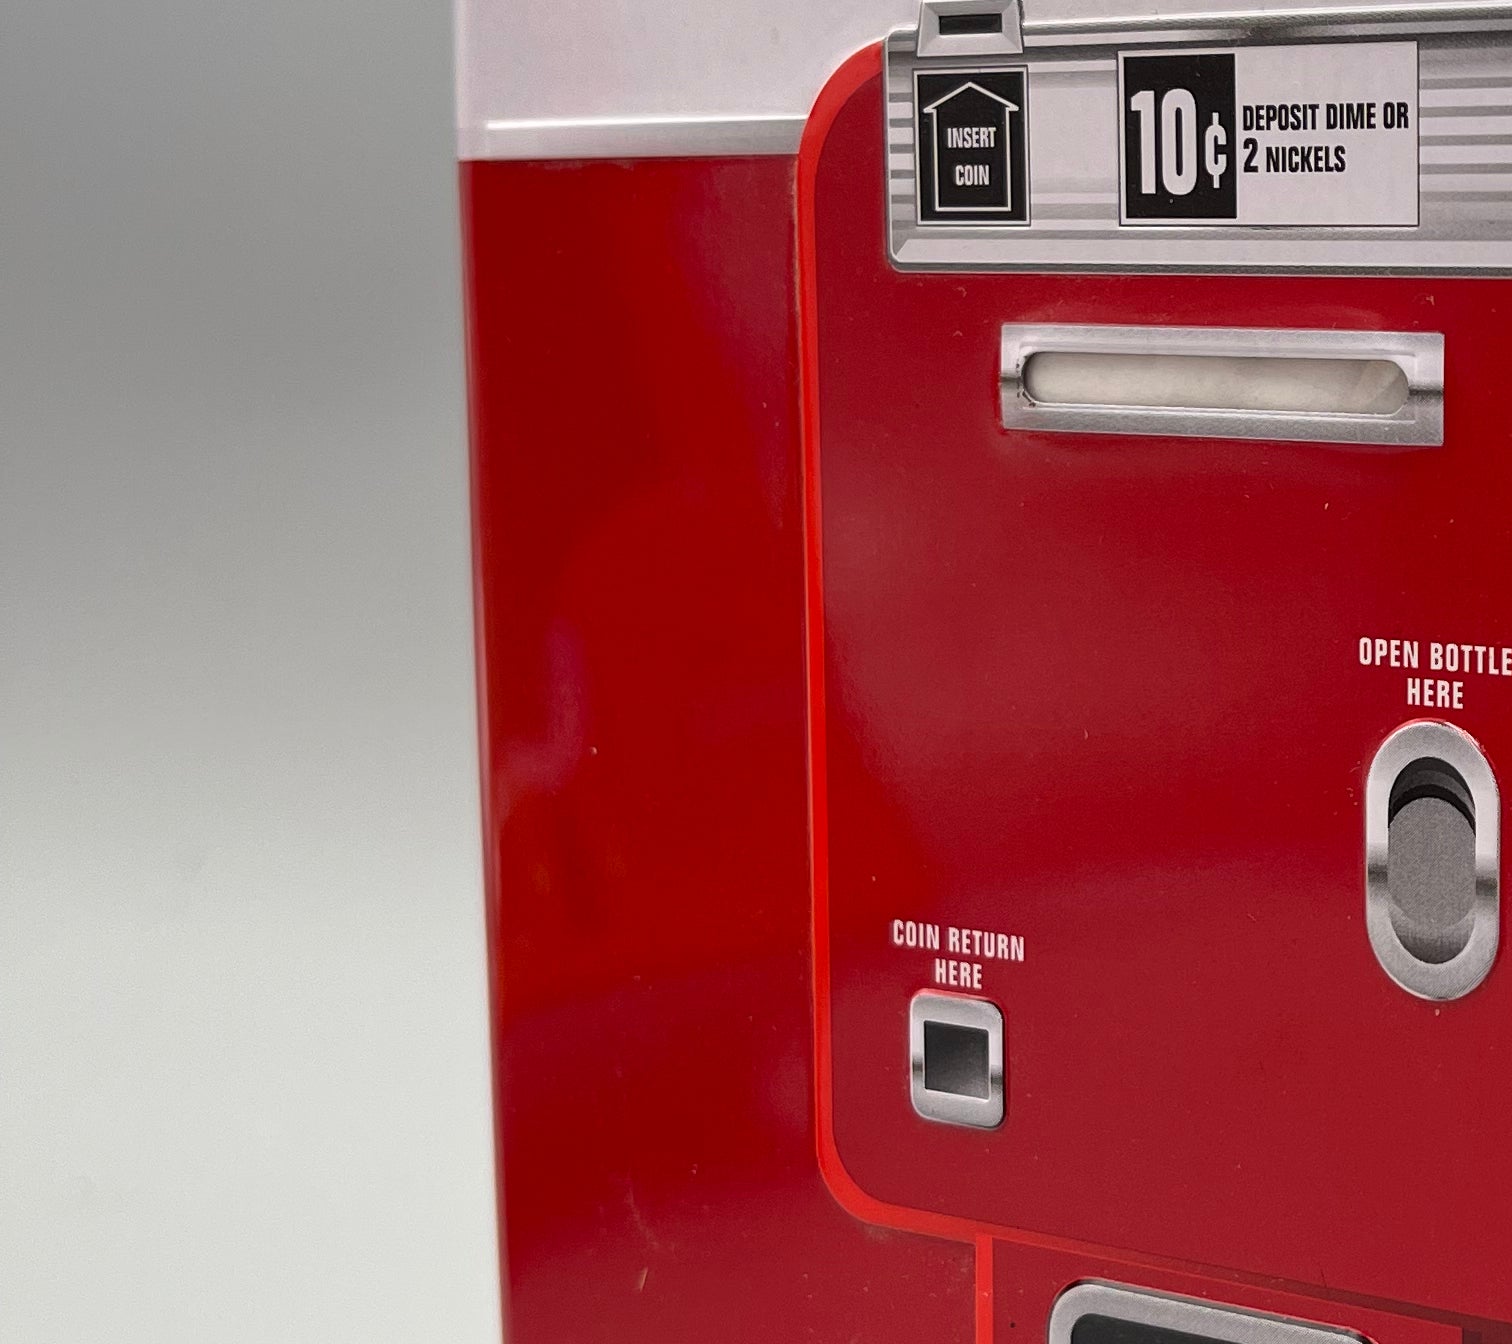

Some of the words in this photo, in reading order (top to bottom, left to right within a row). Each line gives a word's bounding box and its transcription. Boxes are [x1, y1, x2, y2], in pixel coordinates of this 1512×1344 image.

[1242, 103, 1320, 132] DEPOSIT
[1325, 101, 1377, 130] DIME
[1382, 100, 1410, 130] OR
[946, 126, 997, 150] INSERT
[1130, 87, 1228, 196] 10¢
[1243, 137, 1260, 174] 2
[1265, 145, 1347, 174] NICKELS
[954, 164, 991, 187] COIN
[1358, 636, 1420, 669] OPEN
[1406, 676, 1465, 710] HERE
[892, 919, 941, 951] COIN
[947, 926, 1026, 963] RETURN
[933, 958, 983, 990] HERE
